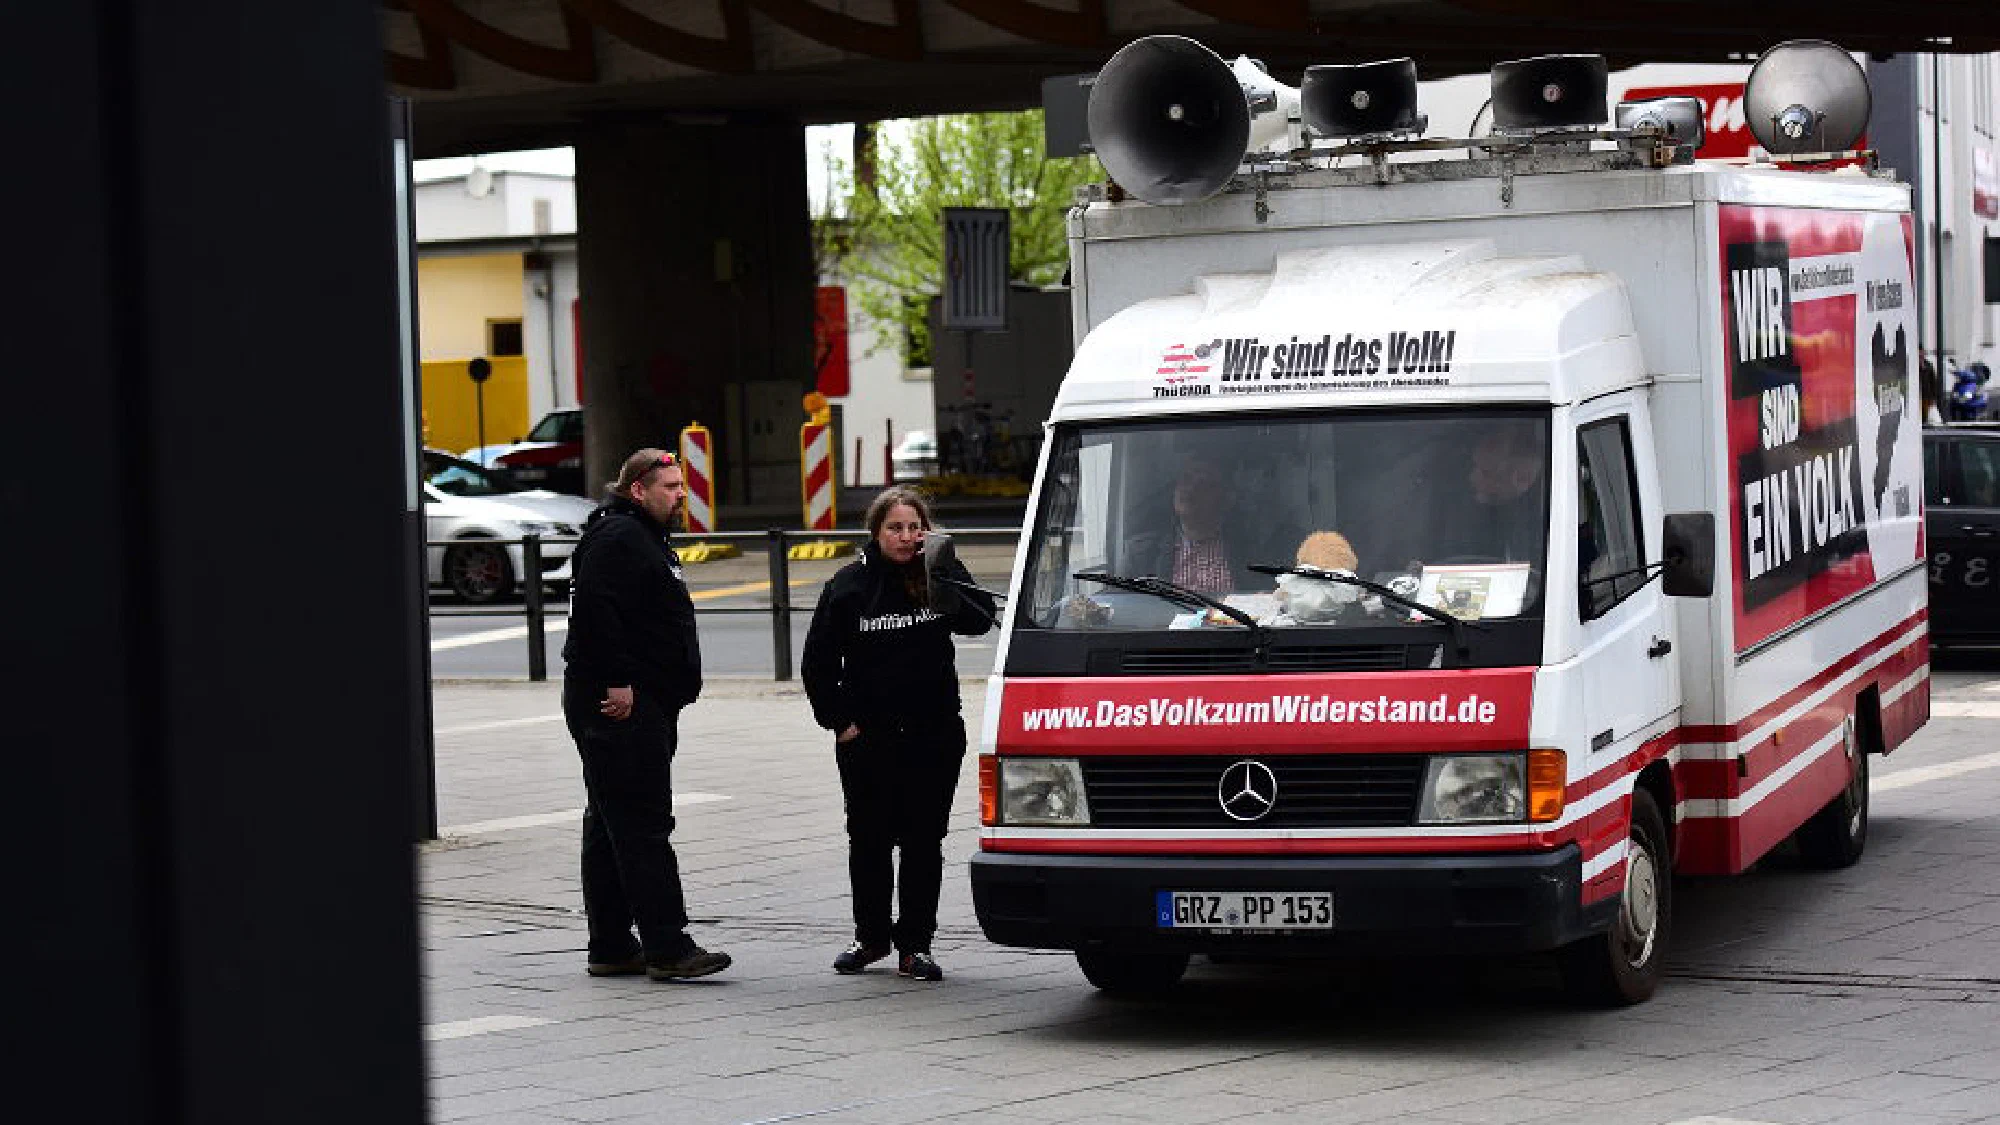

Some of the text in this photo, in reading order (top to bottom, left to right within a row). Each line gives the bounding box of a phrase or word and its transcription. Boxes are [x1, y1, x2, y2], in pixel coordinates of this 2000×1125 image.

[1732, 267, 1786, 363] WIR
[1221, 330, 1456, 381] Wir sind das Volk!
[1762, 383, 1800, 450] SIND
[1744, 446, 1857, 580] EIN VOLK
[1022, 694, 1497, 731] www.DasVolkzumWiderstand.de
[1174, 896, 1223, 924] GRZ
[1243, 896, 1276, 924] PP
[1282, 896, 1331, 924] 153
